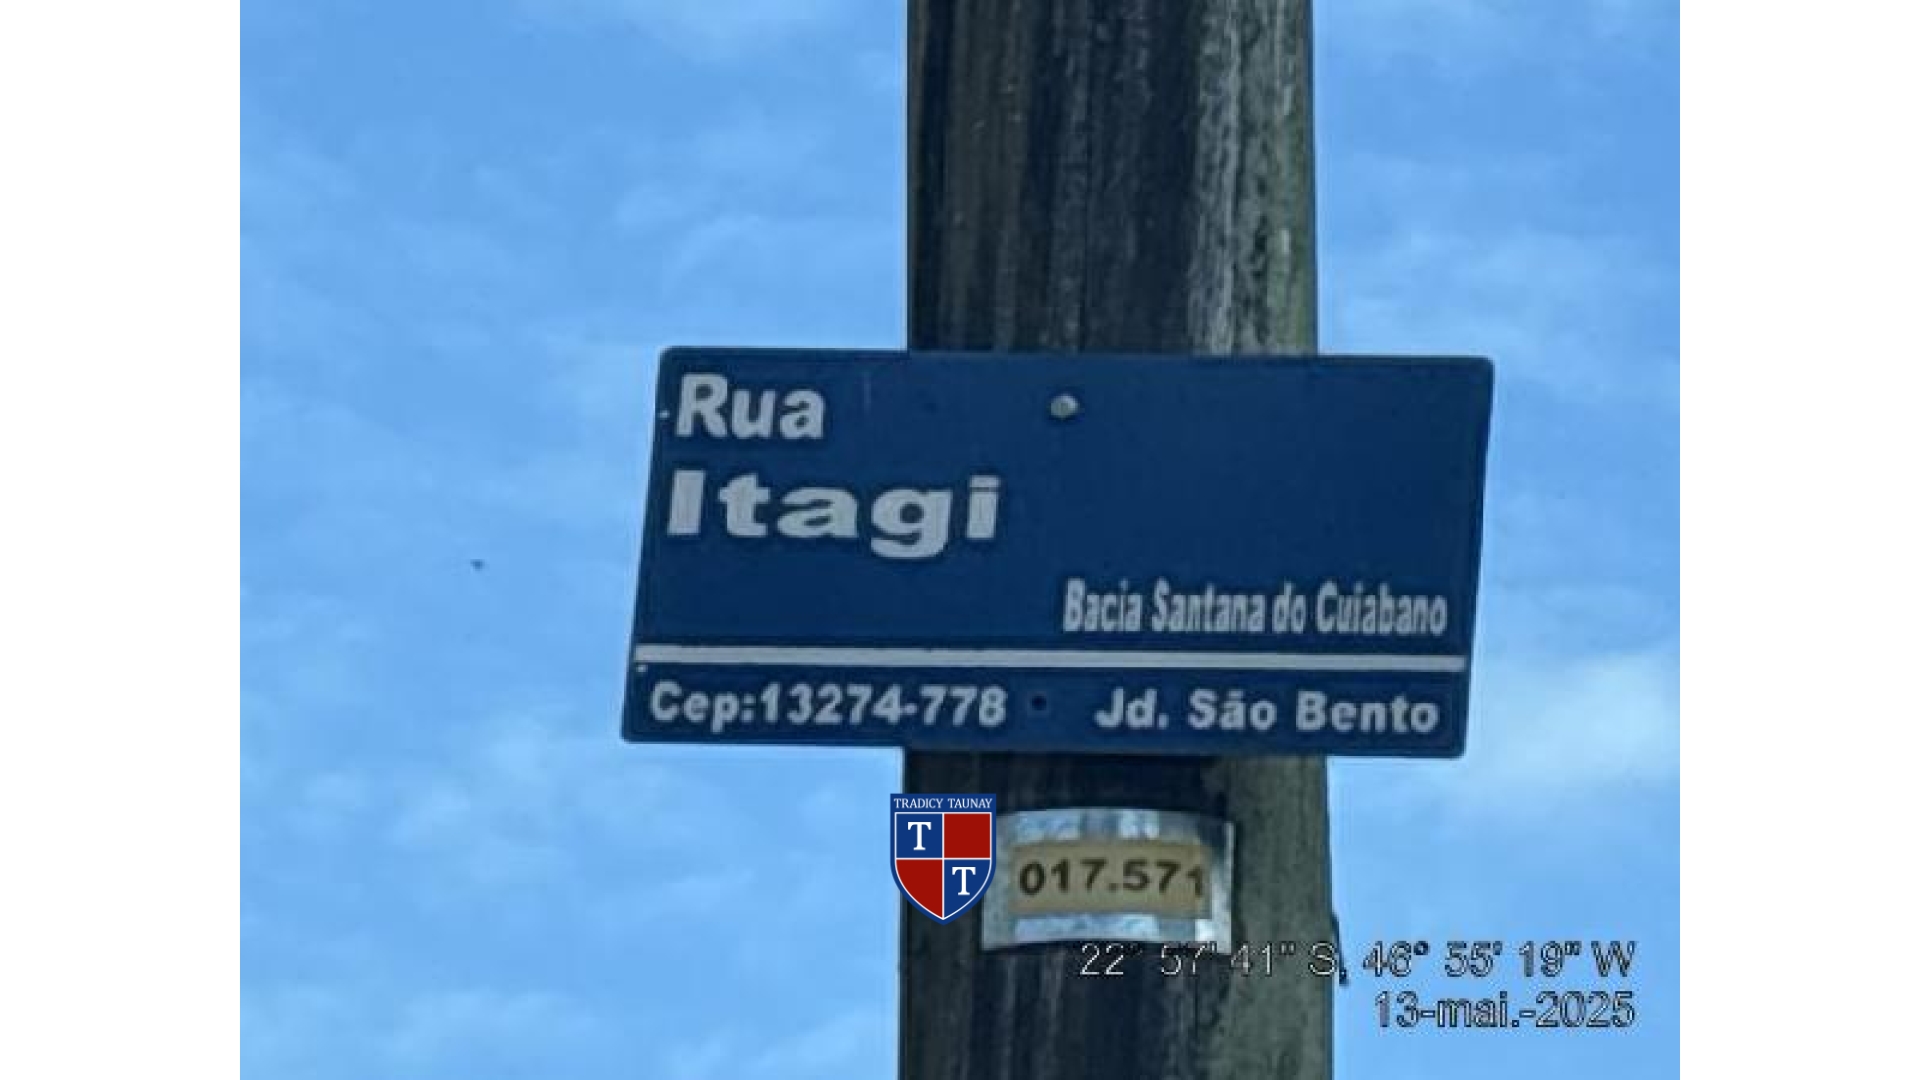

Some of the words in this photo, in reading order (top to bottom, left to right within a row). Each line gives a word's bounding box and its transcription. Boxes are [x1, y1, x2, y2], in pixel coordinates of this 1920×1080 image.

[675, 372, 826, 440] Rua
[666, 469, 1001, 559] Itagi
[1063, 577, 1142, 632] Bacia
[1151, 577, 1266, 634] Santana
[1271, 580, 1306, 635] do
[1315, 580, 1448, 637] Cuiabano
[650, 680, 1007, 733] Cep:13274-778
[1094, 688, 1169, 730] Jd.
[1187, 688, 1278, 732] São
[1296, 690, 1439, 733] Bento
[1018, 858, 1206, 899] 017.571
